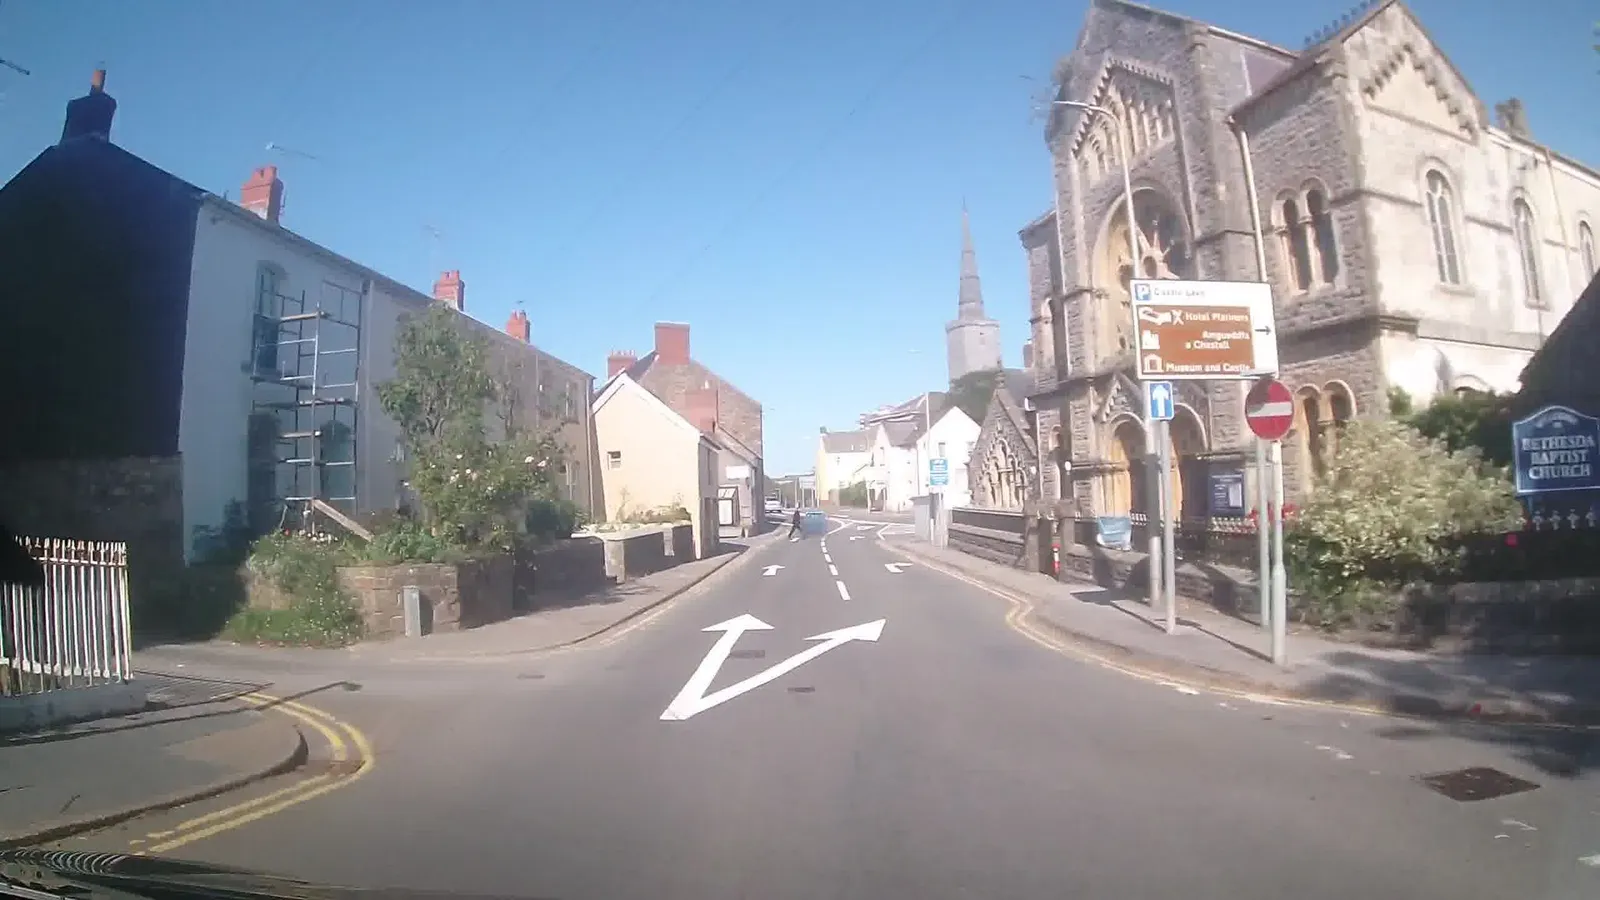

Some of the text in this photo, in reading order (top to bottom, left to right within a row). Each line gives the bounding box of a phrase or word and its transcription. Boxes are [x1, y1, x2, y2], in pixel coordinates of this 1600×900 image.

[1166, 362, 1202, 372] Museum
[1205, 363, 1221, 372] and
[1522, 435, 1596, 451] BETHESDA
[1531, 450, 1589, 465] BAPTIST
[1529, 464, 1591, 479] CHURCH
